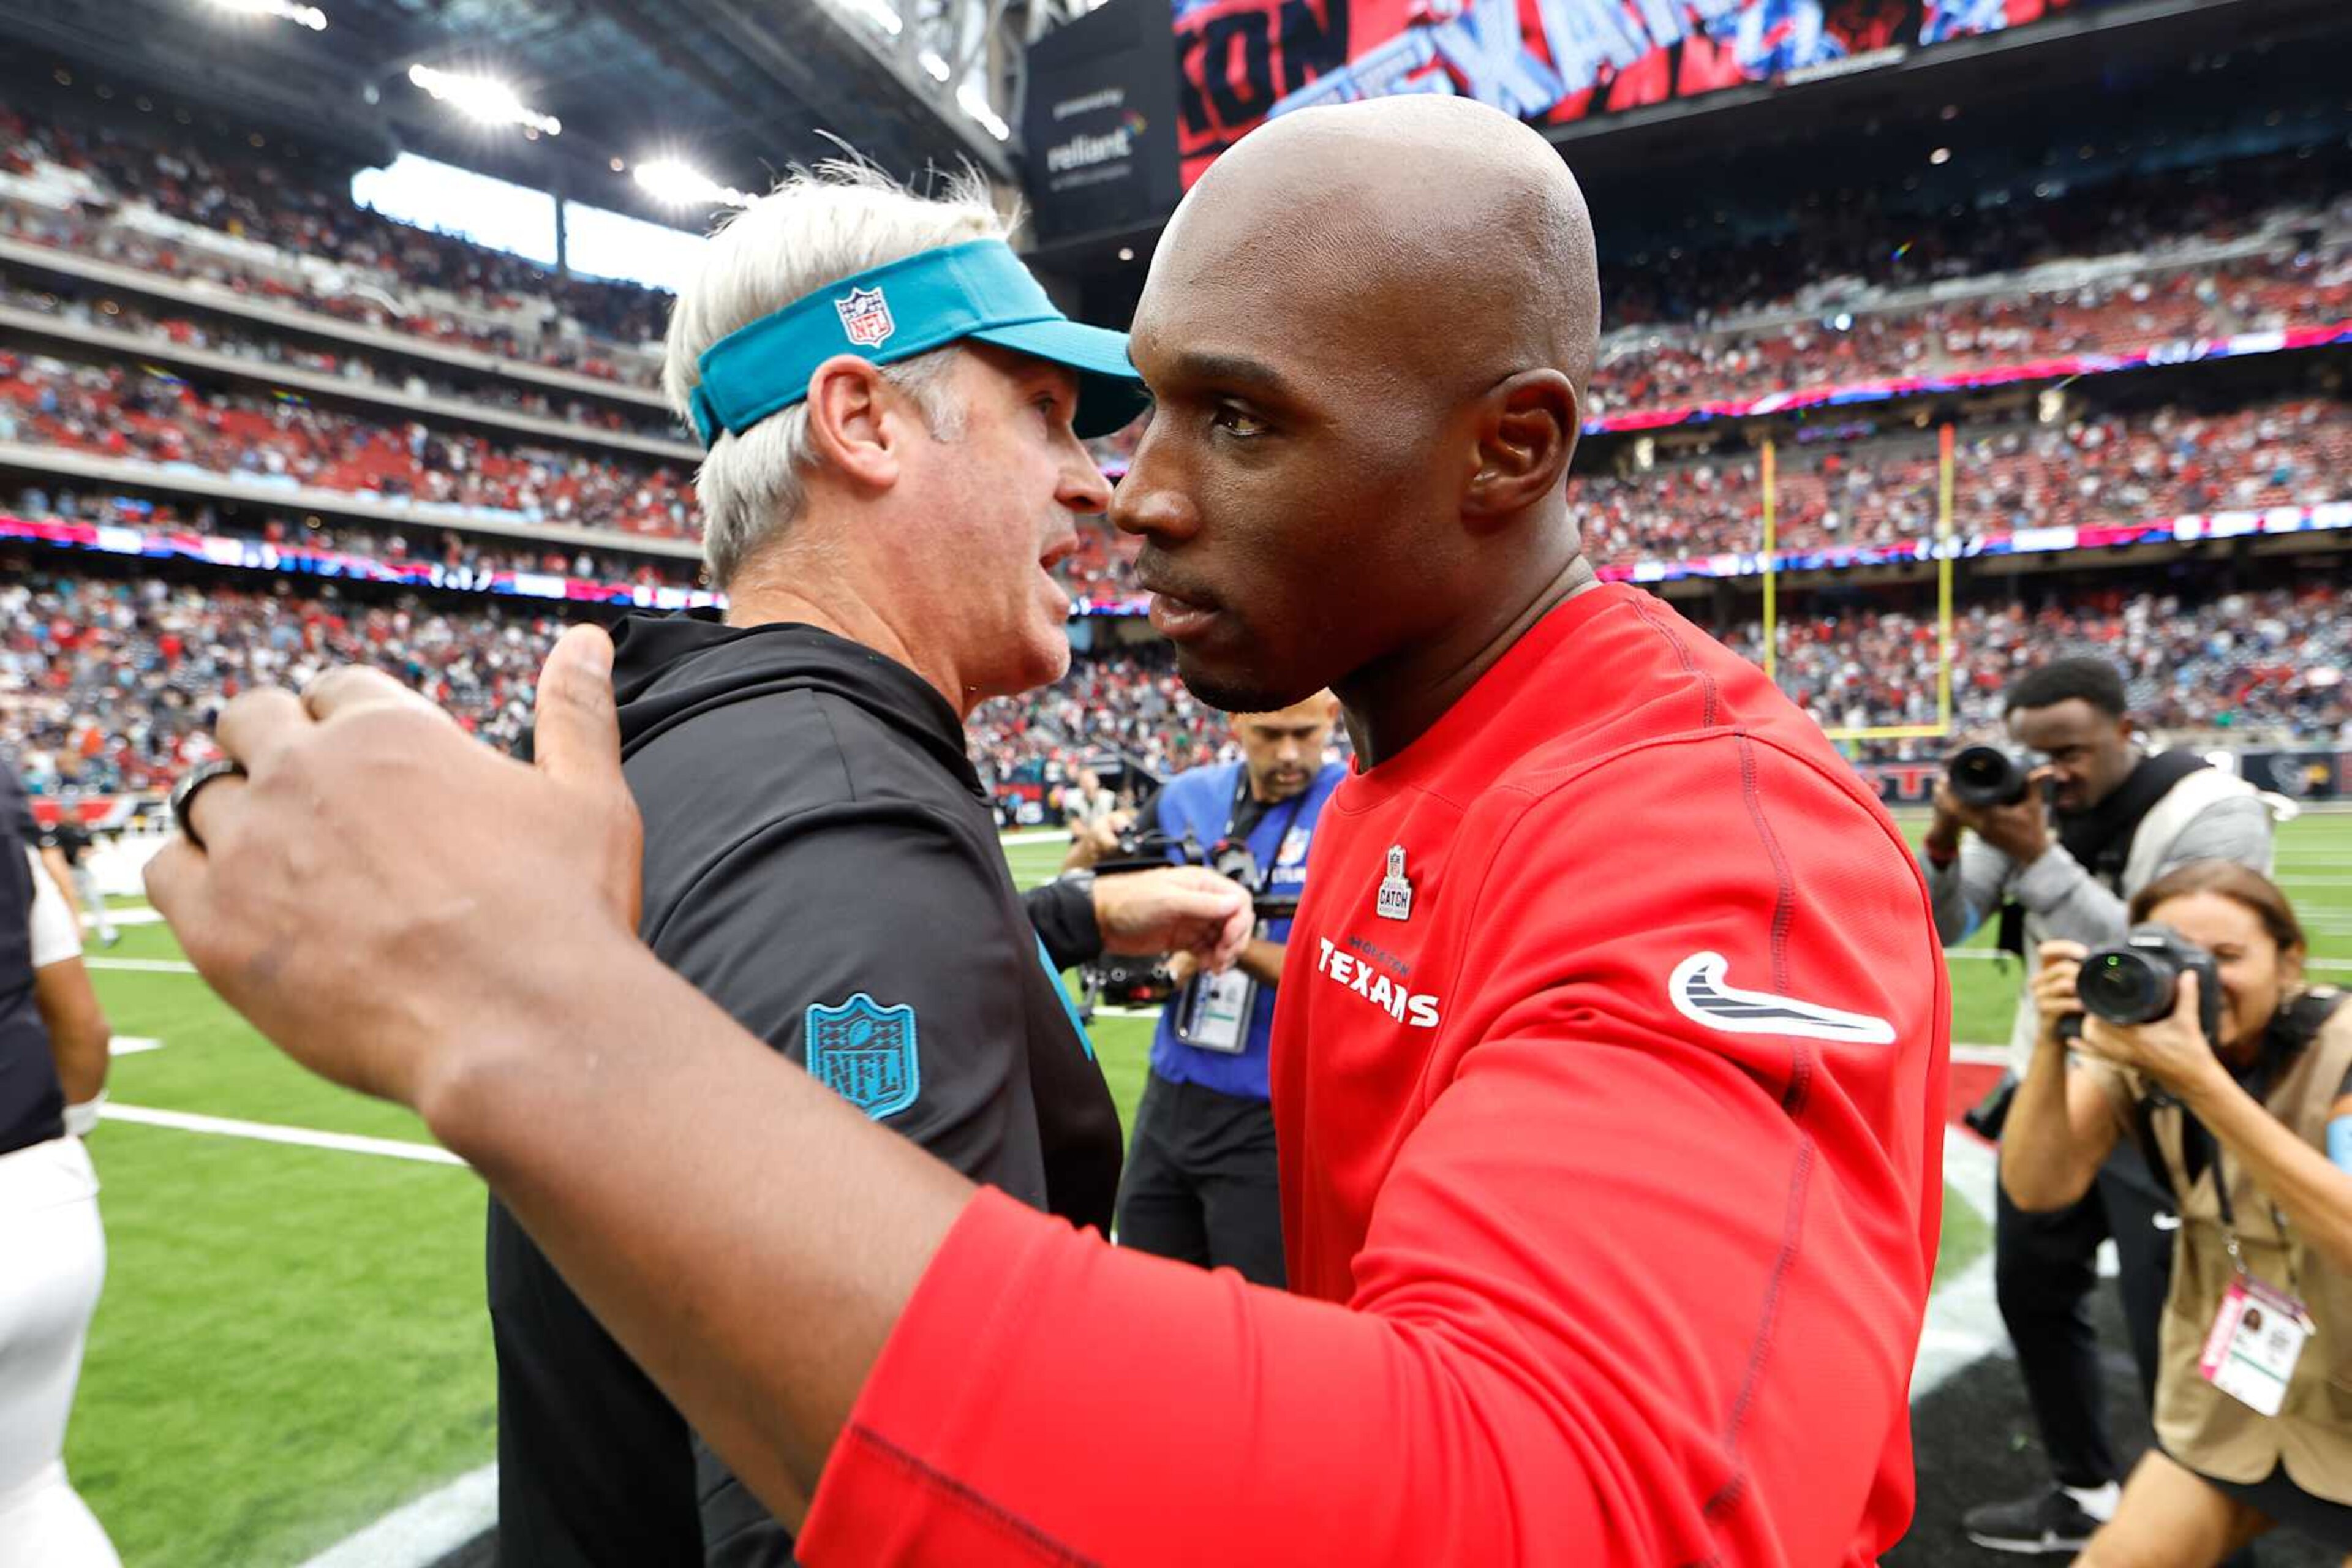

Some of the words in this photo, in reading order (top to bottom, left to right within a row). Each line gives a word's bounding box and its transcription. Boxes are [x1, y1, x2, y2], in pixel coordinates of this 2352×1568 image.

[1379, 888, 1408, 908] CATCH
[1318, 936, 1439, 1028] TEXANS
[823, 1050, 900, 1104] NFL
